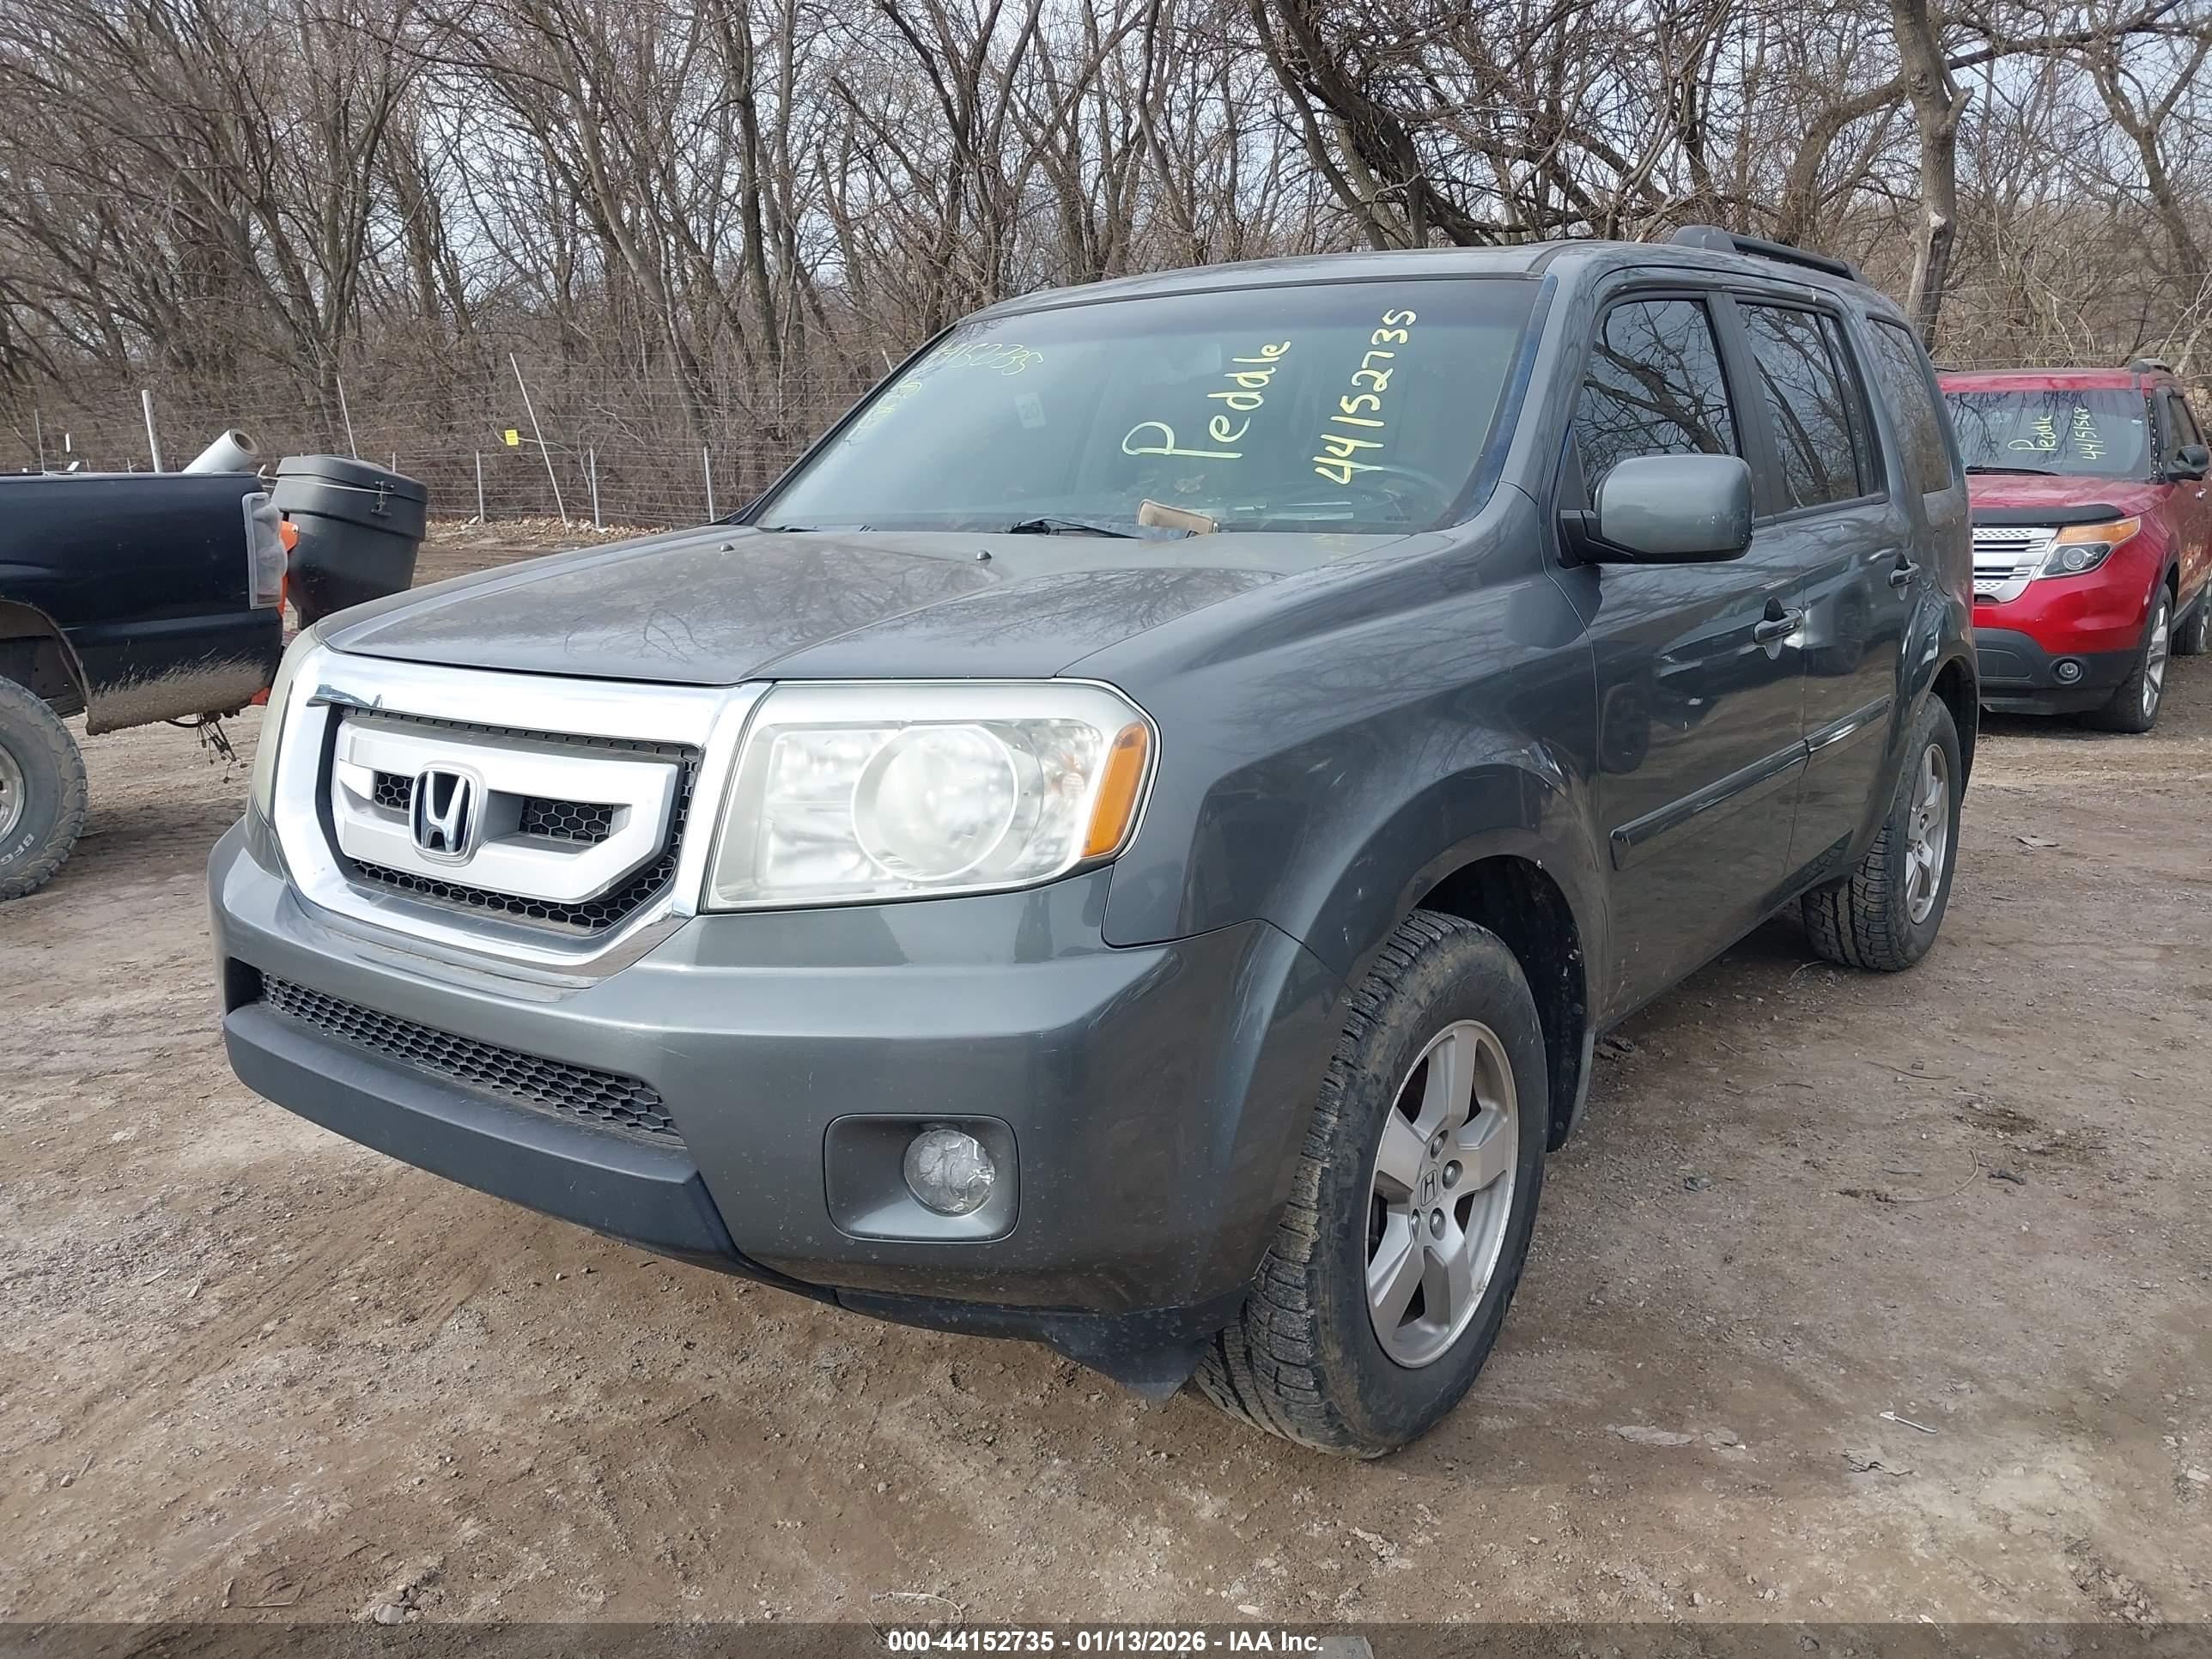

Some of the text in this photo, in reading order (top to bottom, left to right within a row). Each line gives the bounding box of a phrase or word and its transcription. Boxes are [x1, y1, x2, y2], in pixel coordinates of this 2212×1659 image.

[1121, 340, 1292, 459] Peddle
[1311, 307, 1418, 485] 44152735
[2008, 414, 2059, 452] Peddle
